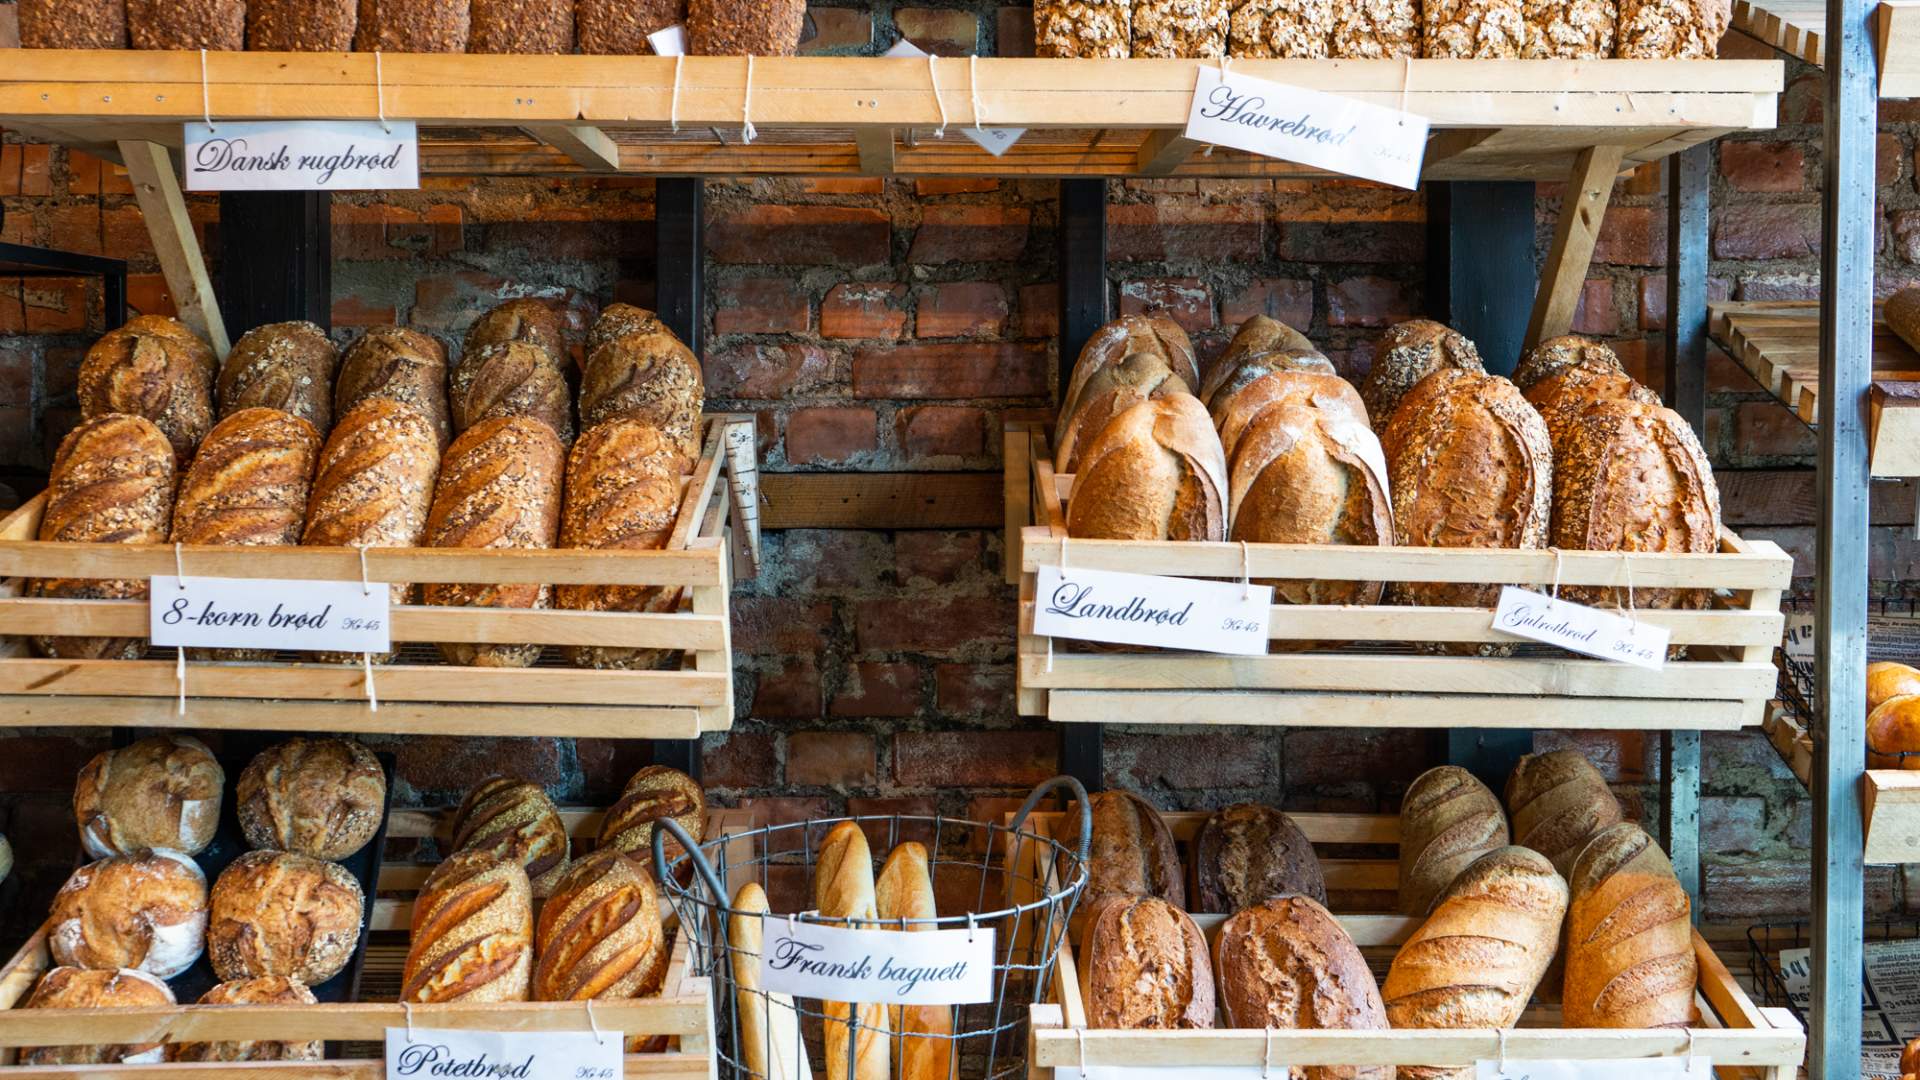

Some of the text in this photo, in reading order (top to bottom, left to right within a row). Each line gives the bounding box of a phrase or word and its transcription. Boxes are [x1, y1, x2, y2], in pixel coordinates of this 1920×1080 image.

[194, 138, 403, 185] Dansk rugbrød
[162, 597, 263, 627] 8-korn
[268, 603, 332, 630] brød
[362, 620, 381, 631] 45
[1045, 582, 1194, 626] Landbrød
[769, 937, 969, 996] Fransk baguett
[397, 1043, 535, 1079] Potetbrød
